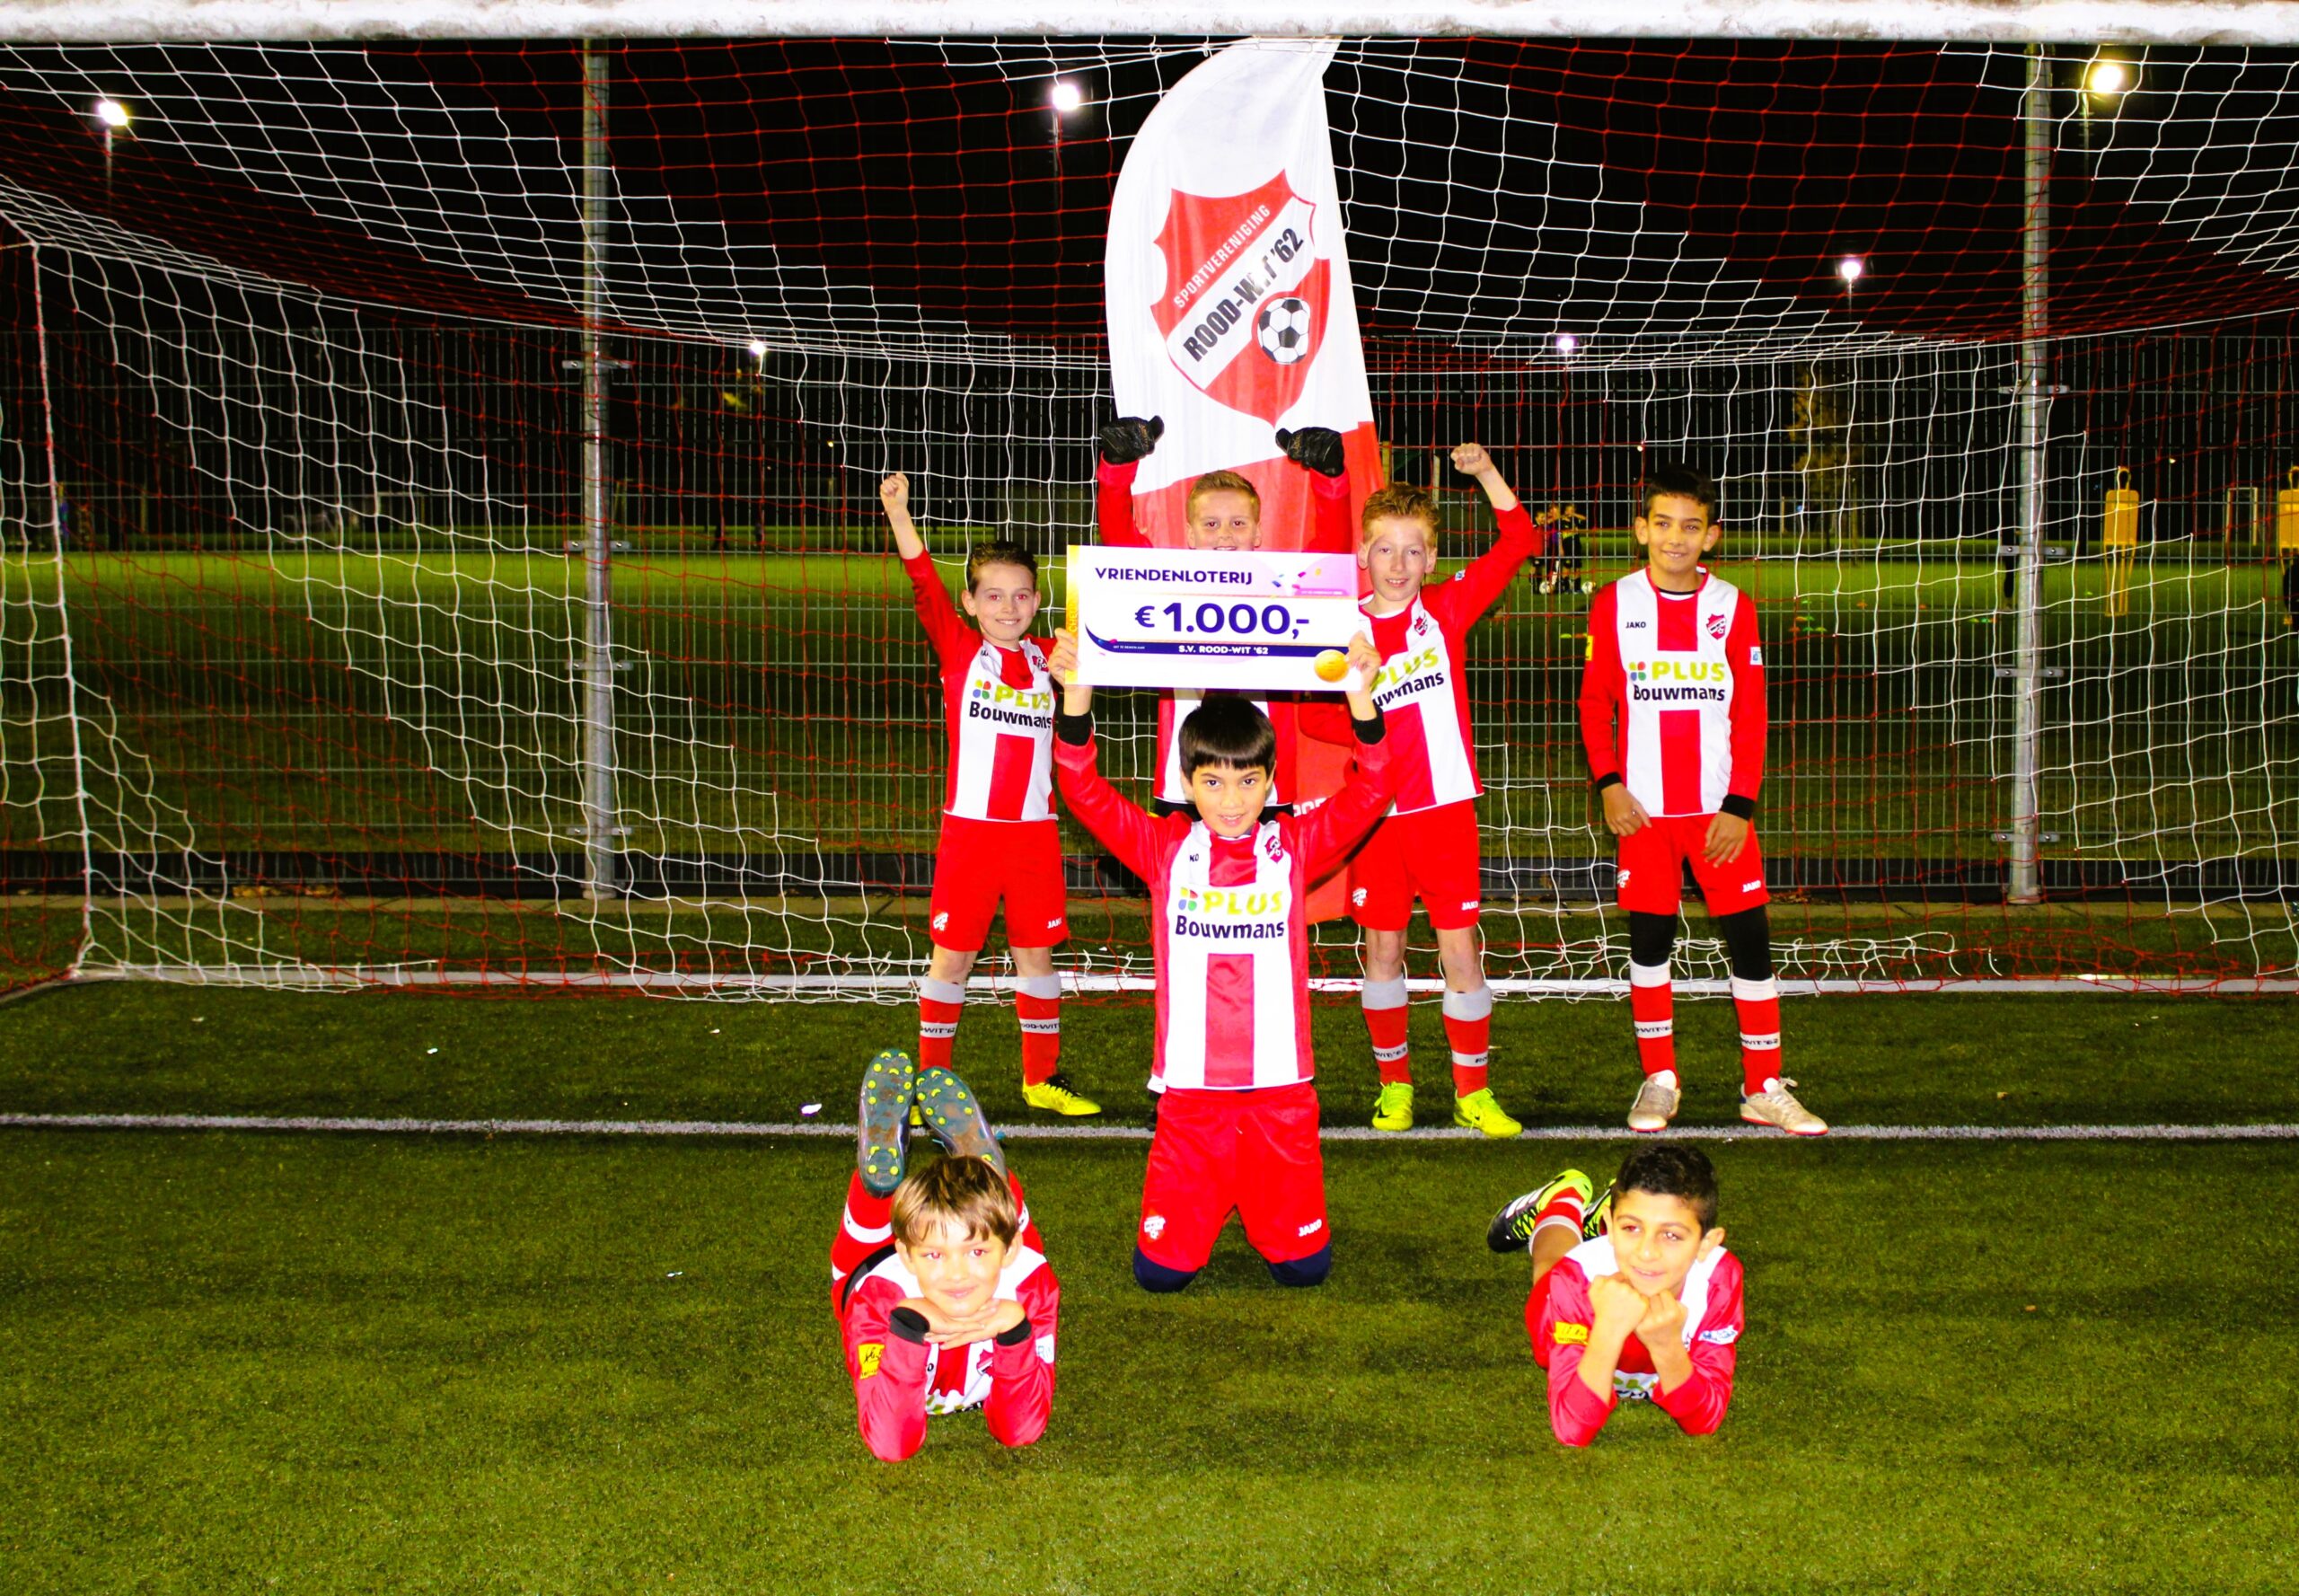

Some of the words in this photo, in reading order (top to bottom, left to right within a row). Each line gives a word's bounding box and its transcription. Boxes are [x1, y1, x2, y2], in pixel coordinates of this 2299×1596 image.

[1174, 204, 1271, 310] SPORTVERENIGING
[1183, 255, 1277, 362] ROOD-WT
[1270, 228, 1304, 263] '62
[1095, 567, 1253, 585] VRIENDENLOTERIJ
[1163, 603, 1309, 639] 1.000,-
[1178, 645, 1196, 654] S.V.
[1199, 646, 1251, 655] ROOD-WIT
[1652, 661, 1725, 682] PLUS
[1634, 684, 1725, 701] Bouwmans
[1202, 891, 1282, 915] PLUS
[1175, 915, 1285, 939] Bouwmans
[1299, 1218, 1322, 1237] JAKO
